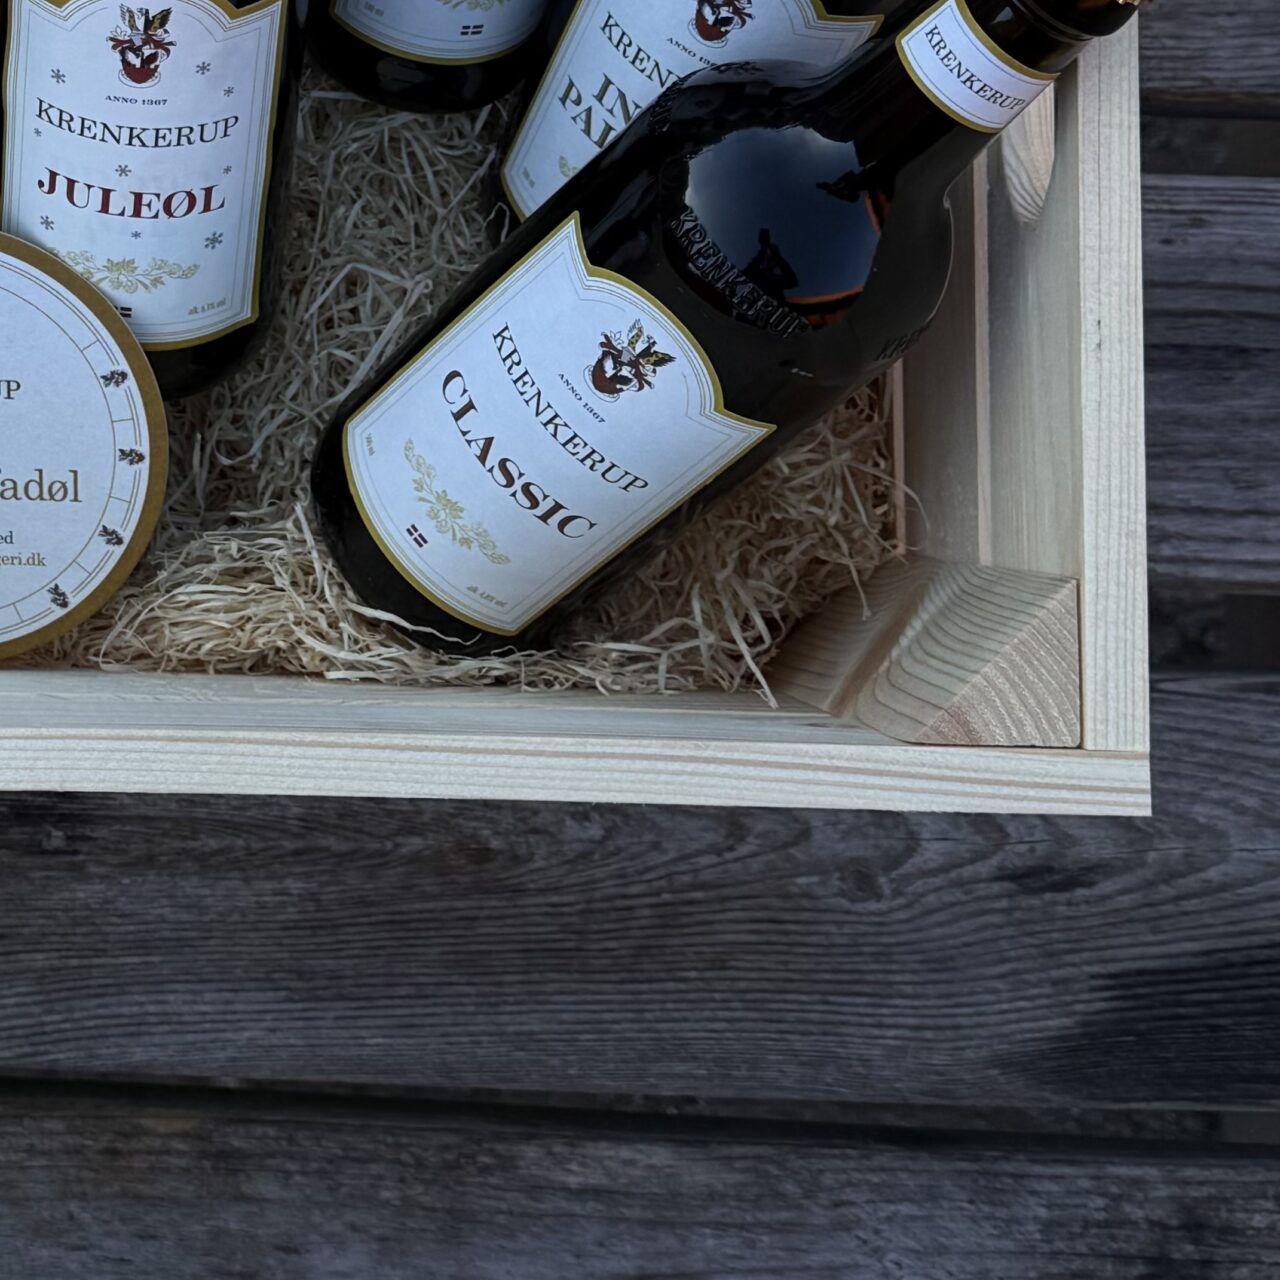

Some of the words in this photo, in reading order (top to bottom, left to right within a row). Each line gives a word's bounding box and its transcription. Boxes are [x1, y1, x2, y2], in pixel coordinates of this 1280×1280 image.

[104, 93, 138, 106] ANNO
[925, 23, 1027, 111] KRENKERUP
[35, 96, 240, 150] KRENKERUP
[558, 74, 619, 150] PAL
[36, 166, 226, 221] JULEØL
[491, 321, 649, 494] KRENKERUP
[557, 372, 584, 403] ANNO
[440, 368, 598, 540] CLASSIC
